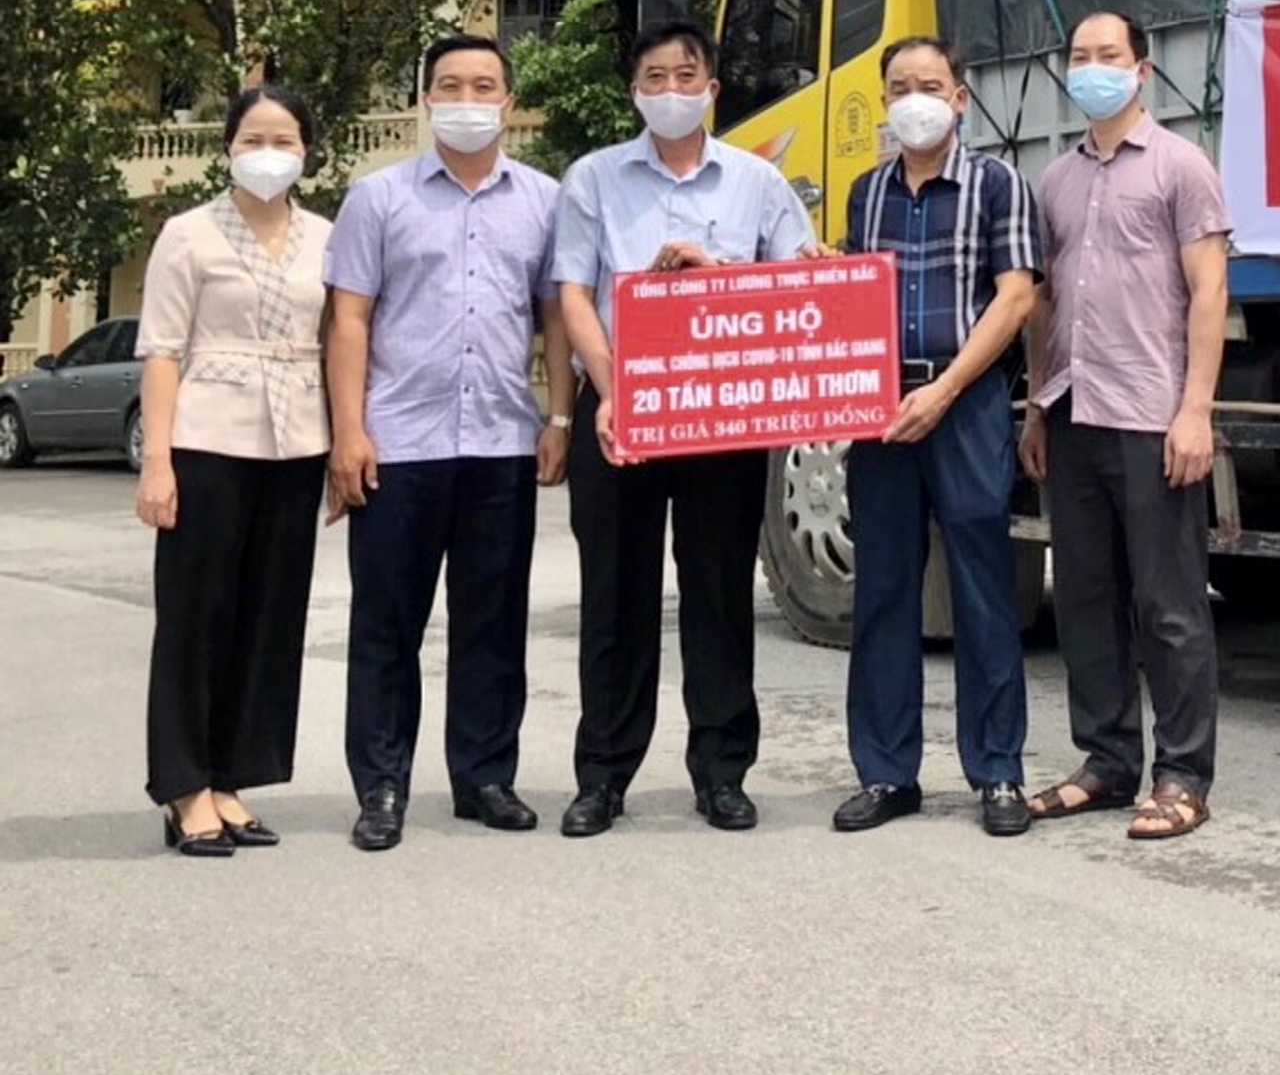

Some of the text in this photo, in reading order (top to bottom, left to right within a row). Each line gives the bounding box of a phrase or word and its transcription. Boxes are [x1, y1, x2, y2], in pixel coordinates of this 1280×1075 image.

[711, 278, 726, 292] TY
[690, 301, 822, 339] ỦNG HỘ
[633, 369, 880, 414] 20 TẤN GẠO ĐÀI THƠM
[628, 426, 665, 445] TRỊ
[670, 419, 710, 440] GIÁ
[714, 418, 747, 437] 340
[751, 410, 818, 433] TRIỆU
